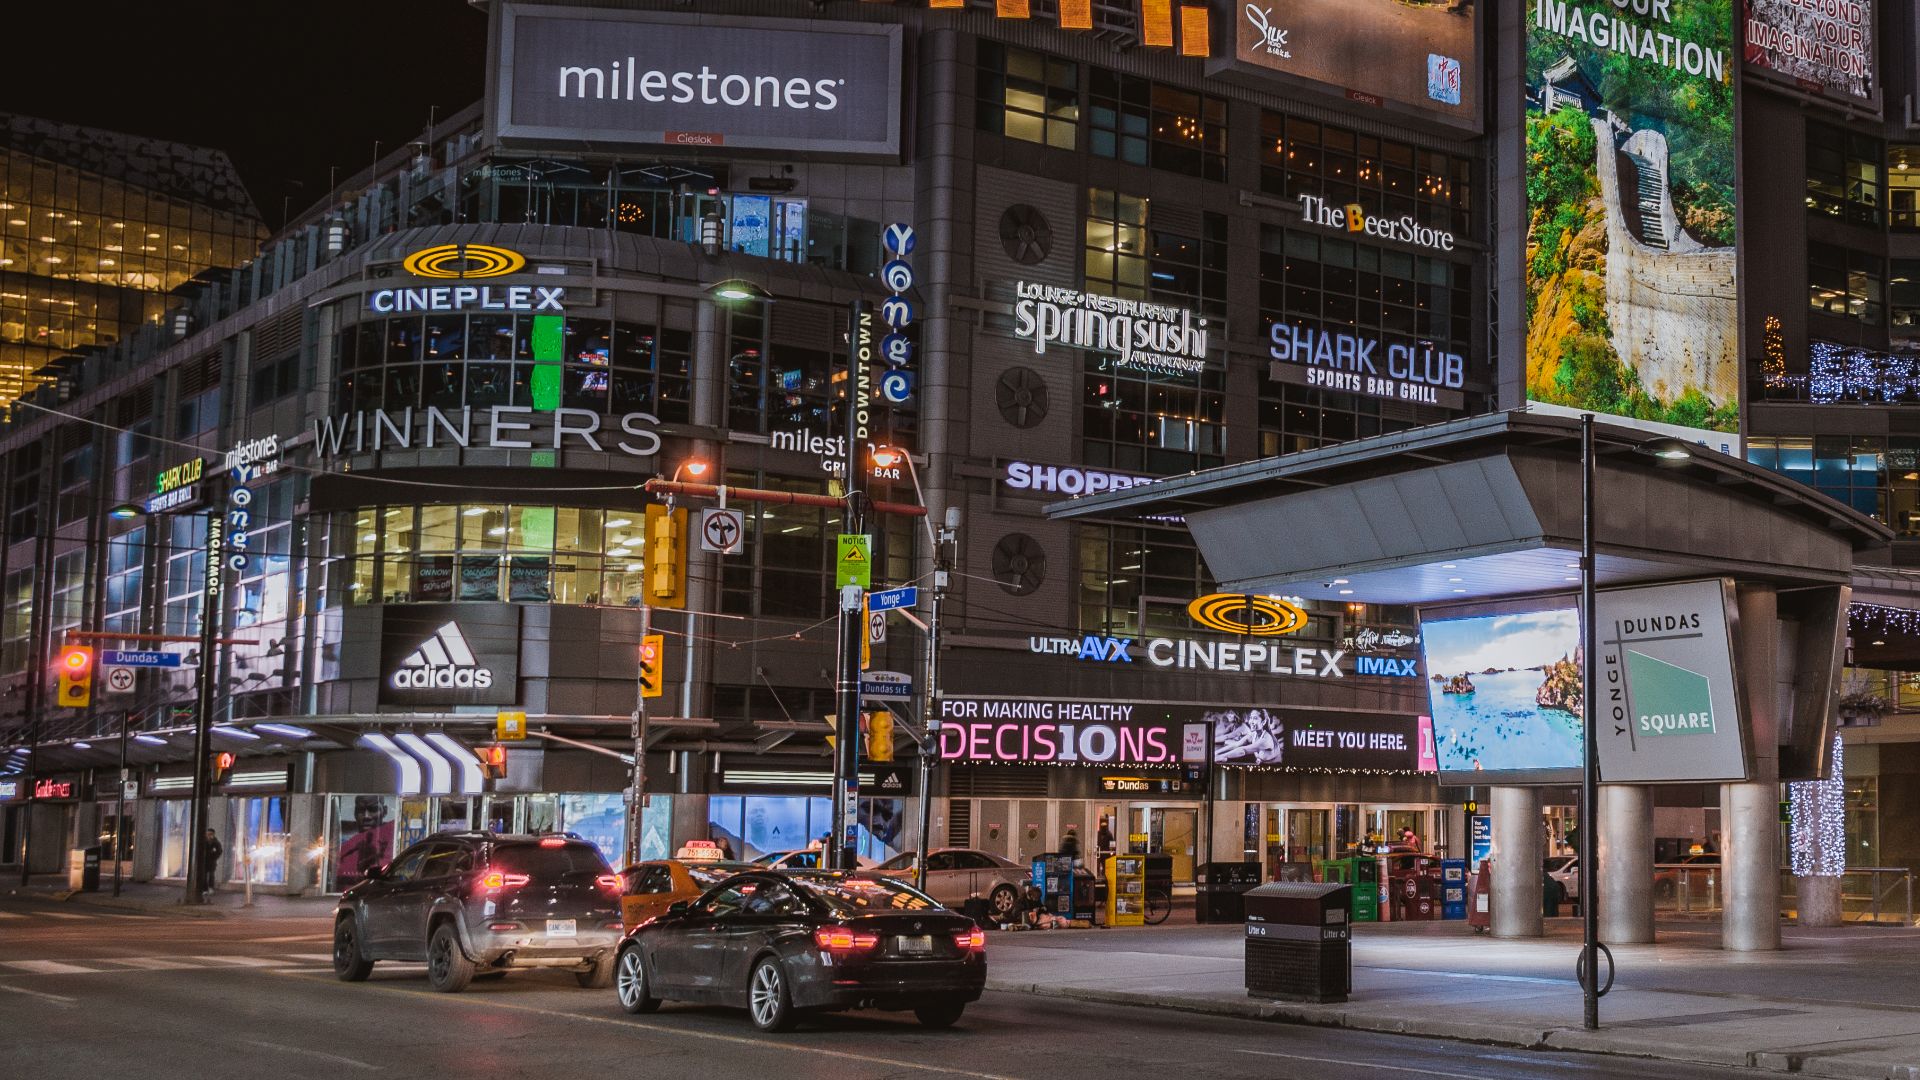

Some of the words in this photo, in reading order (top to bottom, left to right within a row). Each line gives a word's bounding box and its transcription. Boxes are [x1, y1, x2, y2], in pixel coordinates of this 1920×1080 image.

[1790, 0, 1862, 26] YOND
[1537, 0, 1723, 82] IMAGINATION
[1749, 19, 1863, 78] IMAGINATION
[1813, 17, 1863, 51] YOUR
[559, 57, 838, 111] milestones
[1300, 192, 1345, 229] The
[1344, 204, 1400, 239] Beer
[1399, 217, 1454, 251] Store
[373, 286, 564, 312] CINEPLEX
[883, 224, 915, 402] Yonge
[1270, 323, 1377, 375] SHARK
[1388, 344, 1464, 389] CLUB
[856, 313, 872, 439] DOWNTOWN
[1307, 367, 1361, 392] SPORTS
[1367, 378, 1393, 397] BAR
[1400, 382, 1437, 404] GRILL
[314, 405, 662, 457] WINNERS
[226, 434, 278, 470] milestones
[158, 466, 181, 494] SHARK
[182, 457, 203, 485] CLUB
[875, 467, 900, 479] BAR
[230, 465, 252, 571] Yonge
[209, 517, 222, 596] DOWNTOWN
[843, 537, 868, 545] NOTICE
[880, 593, 900, 607] Yonge
[1624, 613, 1701, 634] DUNDAS
[116, 652, 158, 663] Dundas
[1030, 637, 1081, 655] ULTRA
[1079, 636, 1132, 662] AVX
[1148, 637, 1344, 678] CINEPLEX
[393, 666, 493, 688] adidas
[1358, 657, 1417, 677] IMAX
[865, 683, 893, 693] Dundas
[902, 685, 906, 694] E
[1606, 654, 1627, 737] YONGE
[942, 701, 978, 718] FOR
[984, 702, 1053, 719] MAKING
[1058, 703, 1133, 721] HEALTHY
[1641, 711, 1711, 735] SQUARE
[1293, 730, 1334, 748] MEET
[1337, 732, 1365, 749] YOU
[1369, 733, 1407, 751] HERE.
[1423, 728, 1435, 759] 1
[1117, 781, 1149, 790] Dundas
